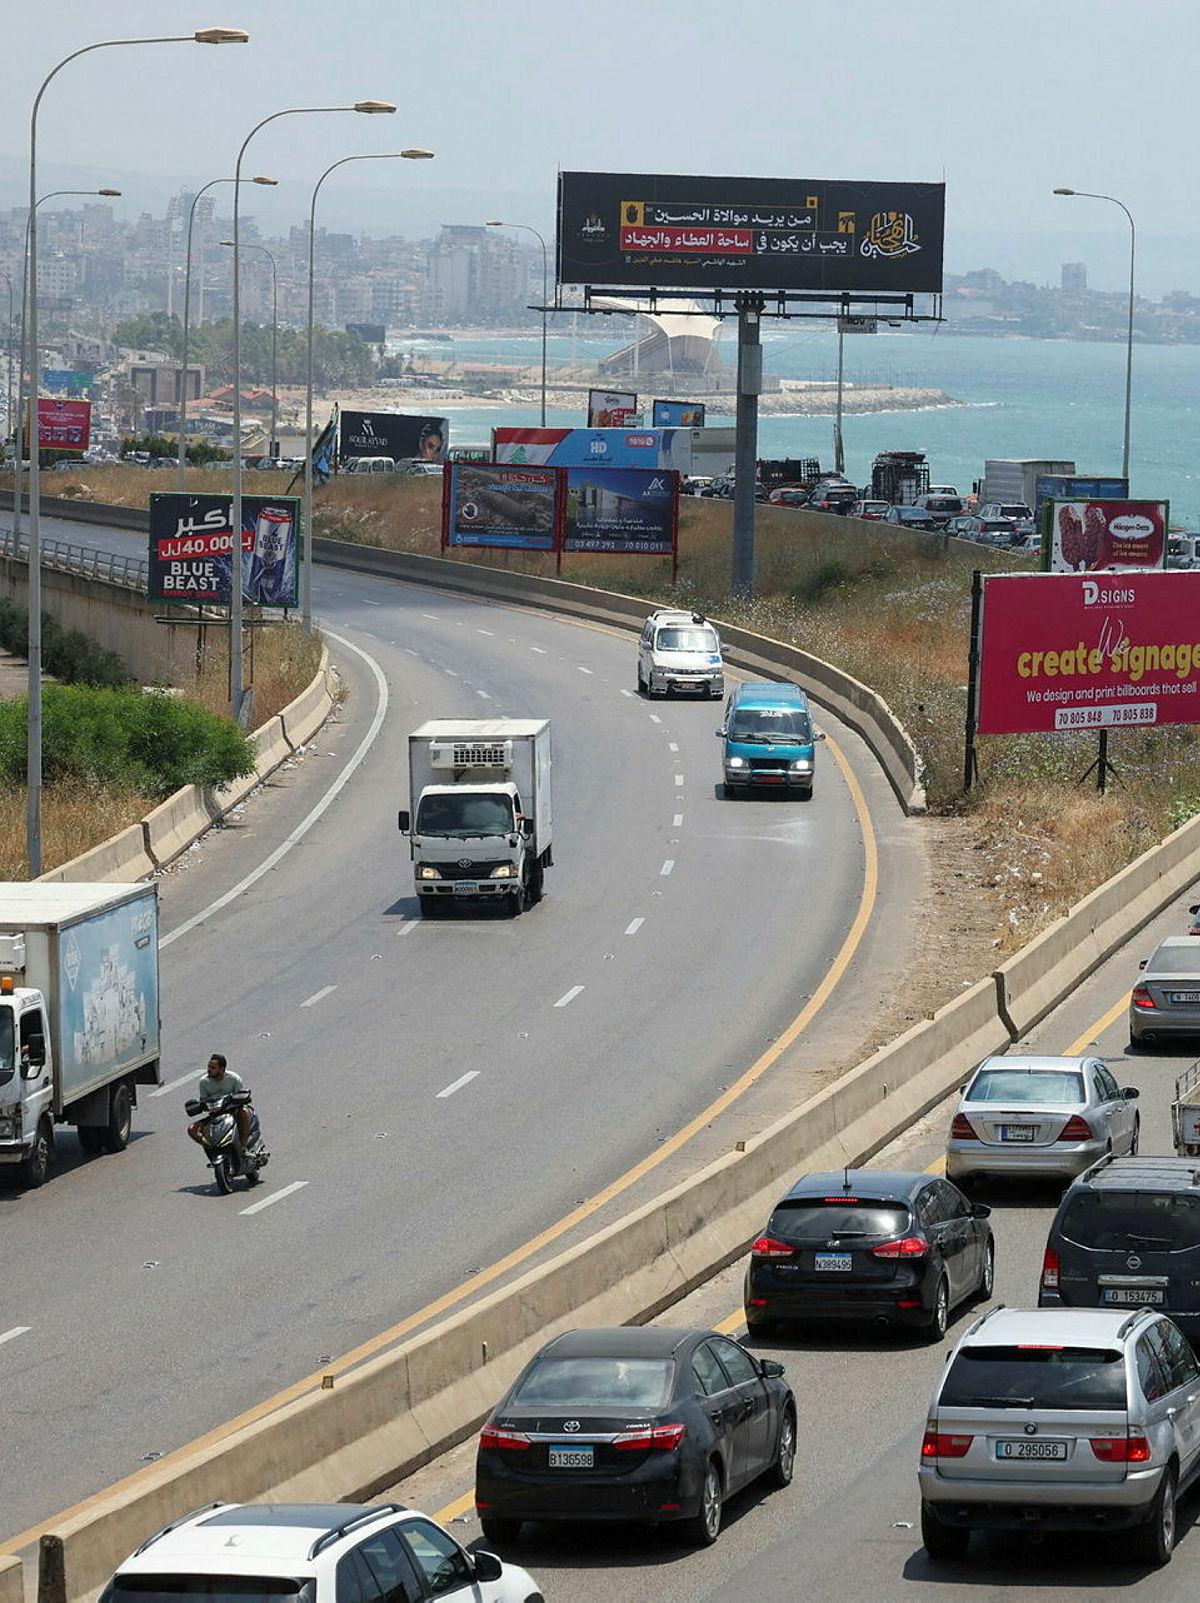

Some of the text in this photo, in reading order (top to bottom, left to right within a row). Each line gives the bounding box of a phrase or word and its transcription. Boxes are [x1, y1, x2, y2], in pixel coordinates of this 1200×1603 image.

[655, 207, 812, 228] من يريد موالاة الحسين
[625, 230, 848, 255] يجب أن يكون في ساحة العطاء والجهاد
[170, 561, 214, 577] BLUE
[163, 575, 220, 591] BEAST
[1017, 641, 1102, 678] create
[1026, 680, 1198, 704] We design and print billboards that sell
[1058, 713, 1069, 725] 70
[1070, 712, 1085, 724] 805
[1112, 709, 1122, 722] 70
[1123, 708, 1138, 721] 805
[1018, 1443, 1059, 1457] 295056
[549, 1453, 593, 1466] B136598
